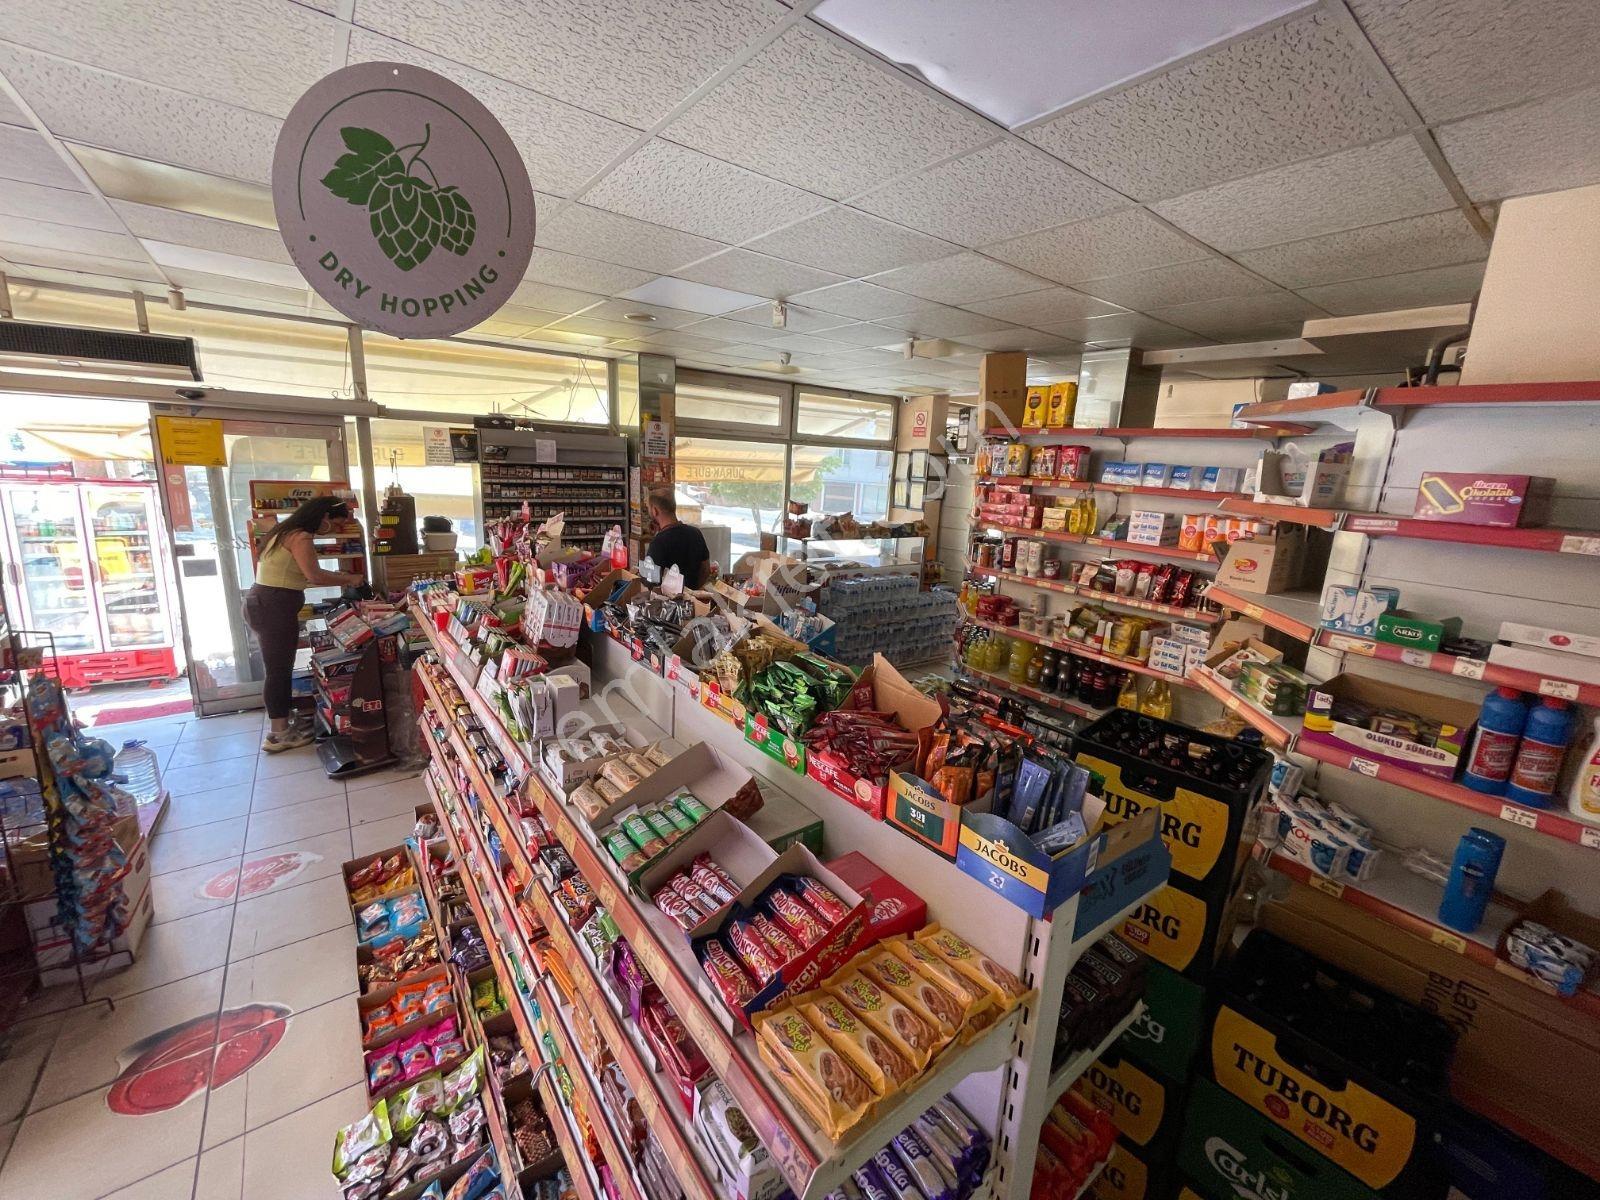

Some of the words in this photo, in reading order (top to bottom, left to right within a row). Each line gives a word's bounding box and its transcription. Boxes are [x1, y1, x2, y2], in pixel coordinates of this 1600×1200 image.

[319, 251, 371, 298] DRY
[380, 264, 498, 317] HOPPING
[292, 488, 312, 497] first
[1366, 732, 1403, 748] OLUKLU
[1406, 742, 1447, 761] SÜNGER
[904, 787, 936, 810] JACOBS
[975, 839, 1028, 878] JACOBS
[707, 939, 741, 976] CRUNCH
[730, 922, 760, 959] CRUNCH
[1233, 1042, 1380, 1154] TUBORG
